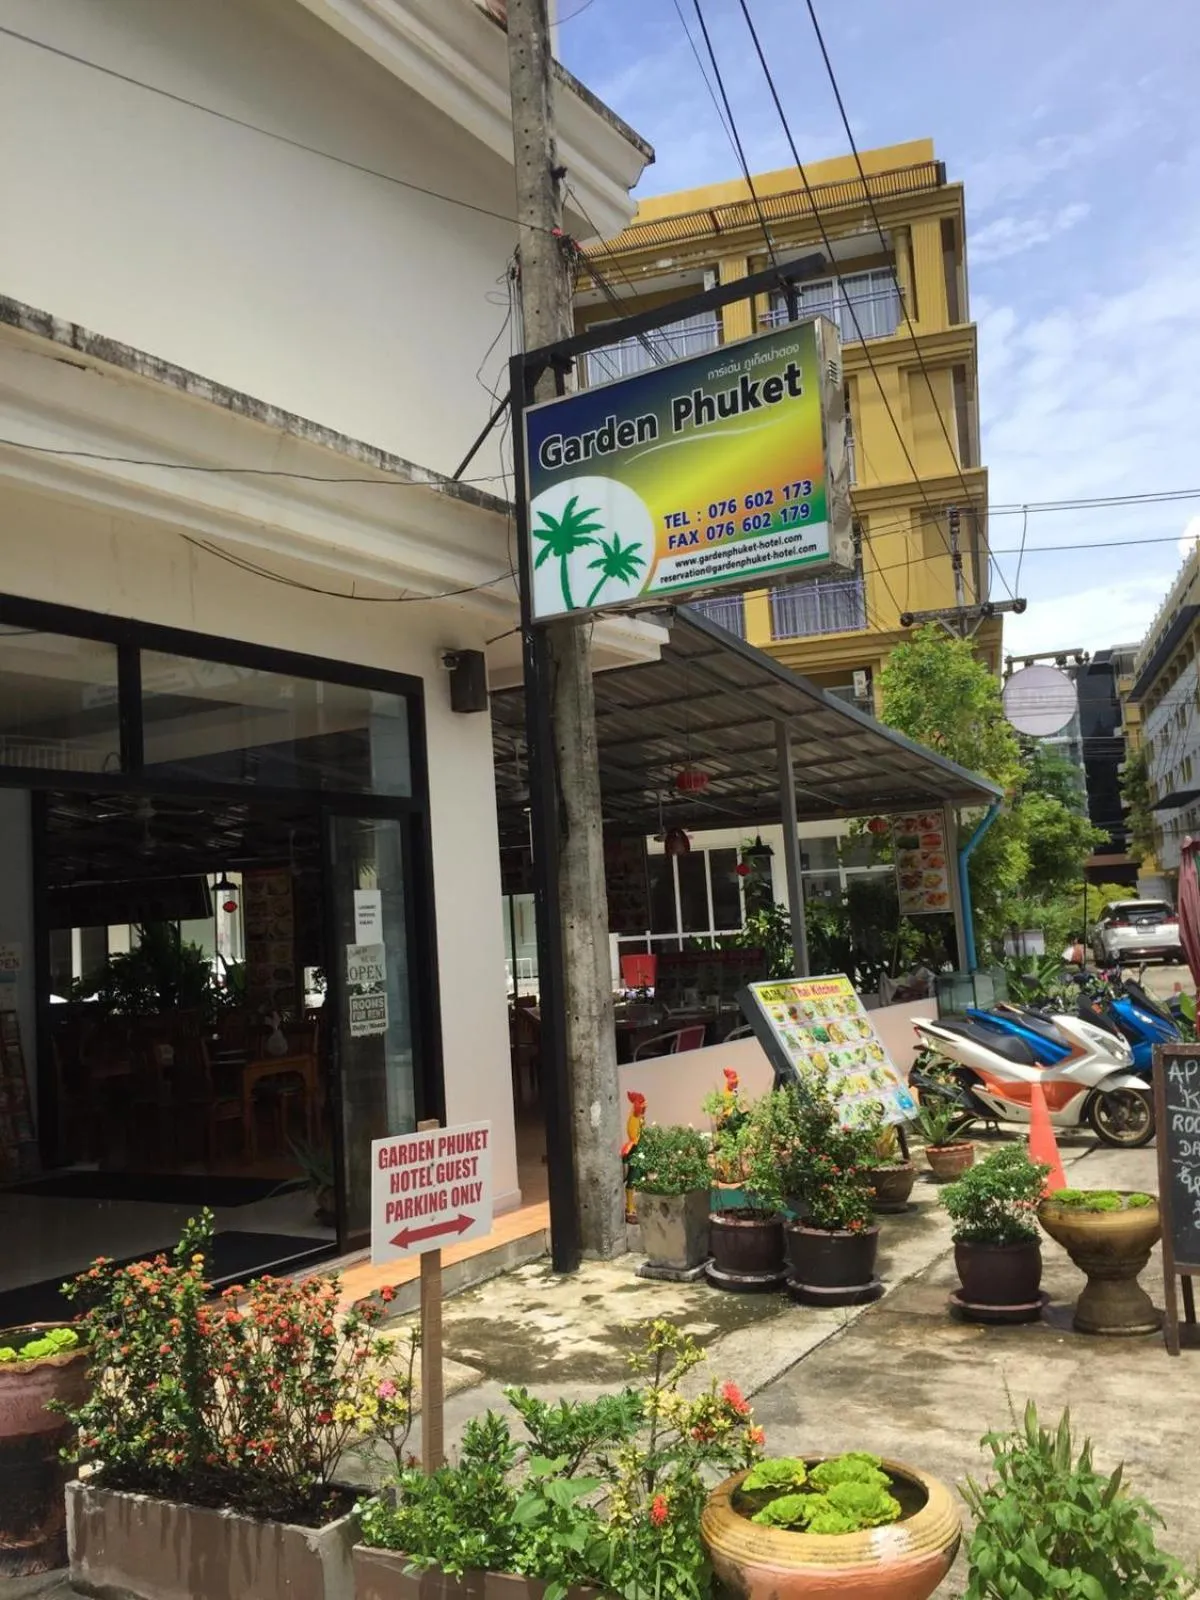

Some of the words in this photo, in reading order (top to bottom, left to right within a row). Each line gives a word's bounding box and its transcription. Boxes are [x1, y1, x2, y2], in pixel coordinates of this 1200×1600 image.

[540, 413, 657, 470] Garden
[671, 363, 803, 434] Phuket
[664, 511, 690, 529] TEL
[708, 499, 737, 519] 076
[744, 490, 774, 509] 602
[782, 480, 812, 501] 173
[668, 529, 700, 549] FAX
[706, 521, 735, 541] 076
[742, 512, 772, 532] 602
[780, 503, 810, 523] 179
[660, 542, 817, 584] reservation@gardenphuket-hotel.com
[675, 533, 803, 569] www.gardenphuket-hotel.com
[349, 964, 383, 981] OPEN
[352, 997, 384, 1010] ROOMS
[378, 1139, 435, 1170] GARDEN
[437, 1129, 489, 1159] PHUKET
[390, 1165, 433, 1194] HOTEL
[436, 1156, 479, 1185] GUEST
[385, 1189, 448, 1225] PARKING
[450, 1181, 483, 1211] ONLY
